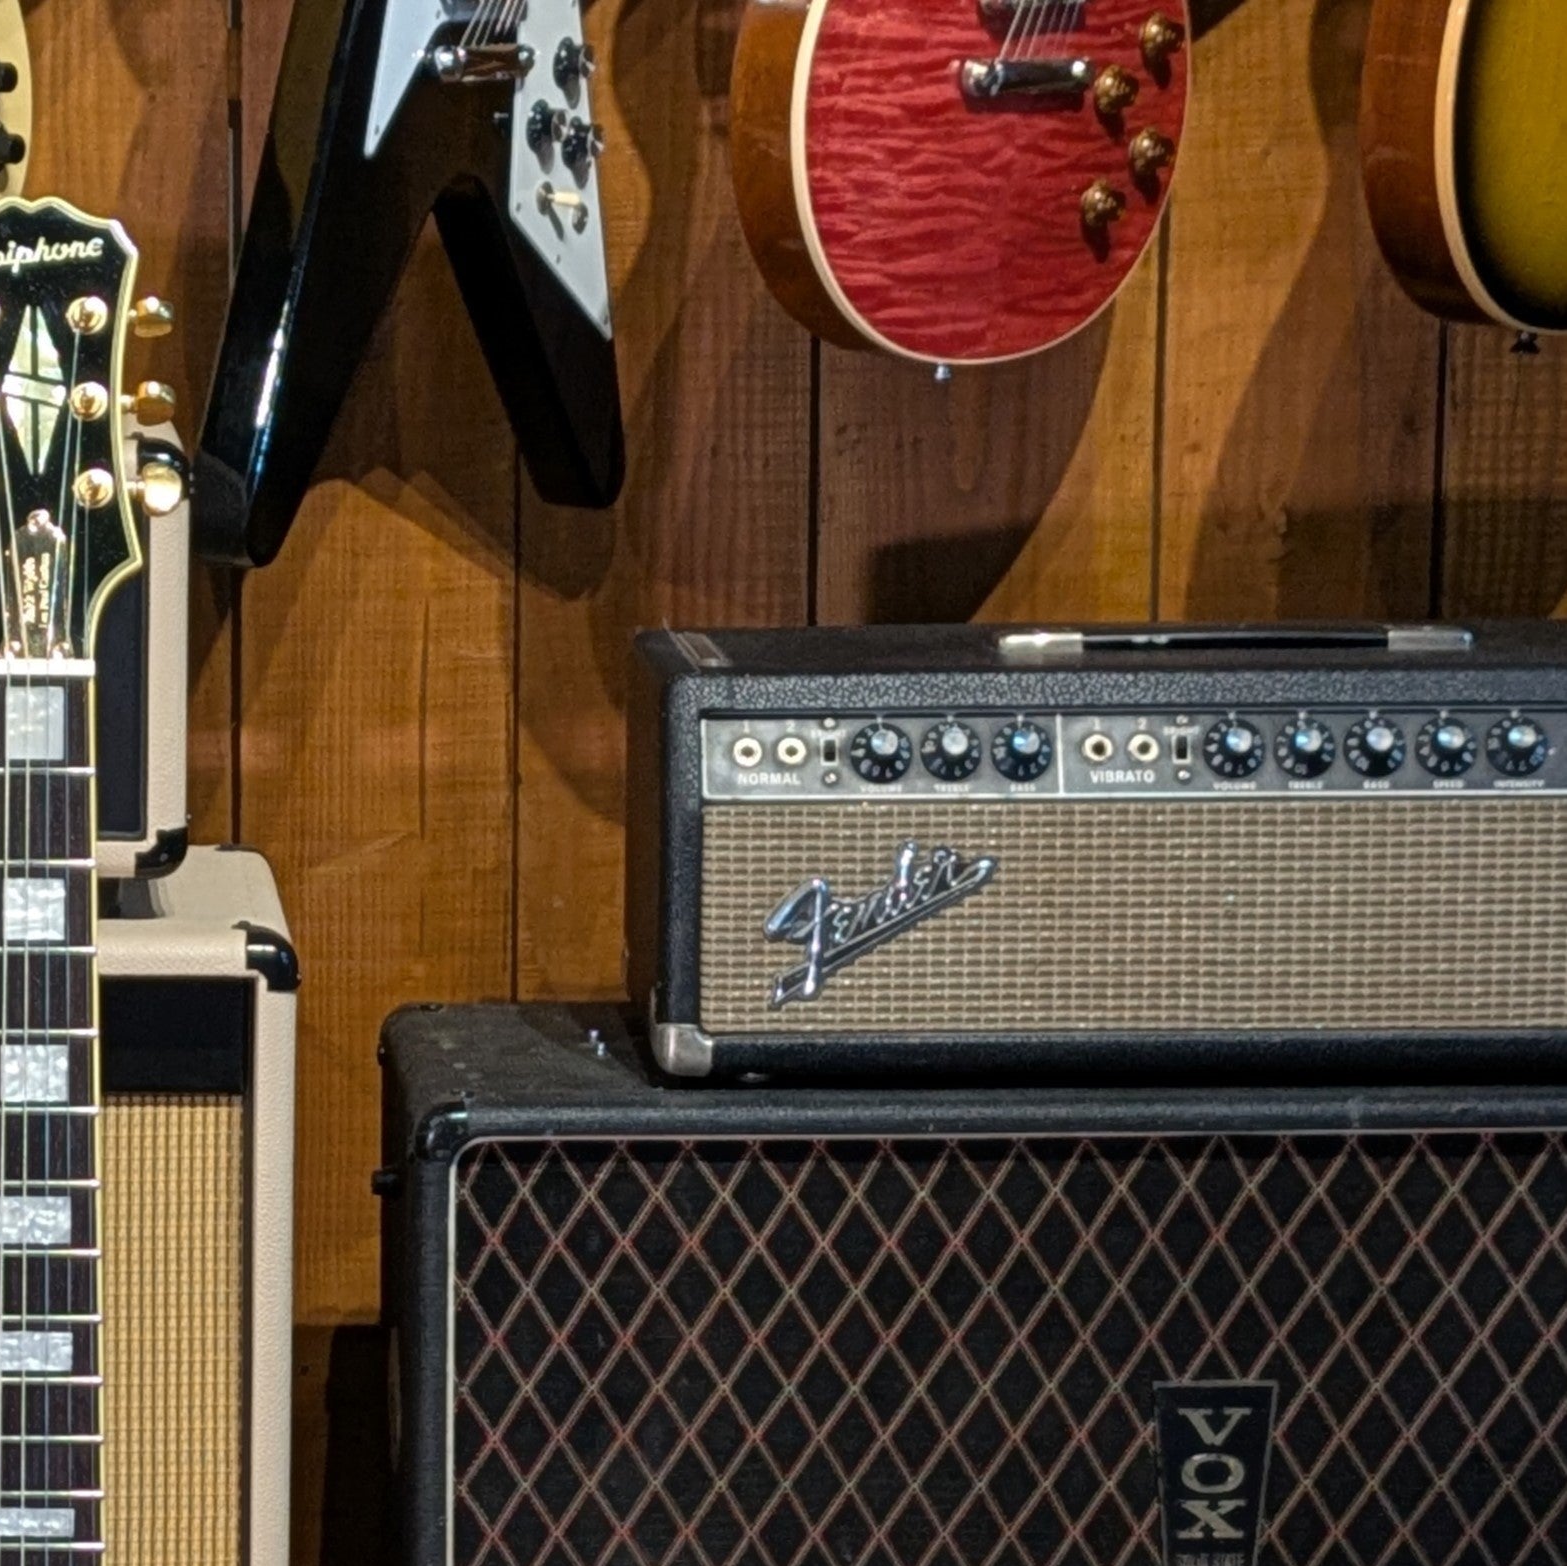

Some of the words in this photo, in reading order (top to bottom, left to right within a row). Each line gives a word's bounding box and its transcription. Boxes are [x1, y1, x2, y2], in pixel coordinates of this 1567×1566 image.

[737, 773, 801, 786] NORMAL
[1090, 770, 1155, 784] VIBRATO
[859, 784, 902, 793] VOLUME
[934, 783, 970, 792] TREBLE
[1212, 780, 1257, 791] VOLUME
[1288, 780, 1324, 790] TREBLE
[764, 838, 998, 1009] Fender
[1177, 1407, 1253, 1540] VOX
